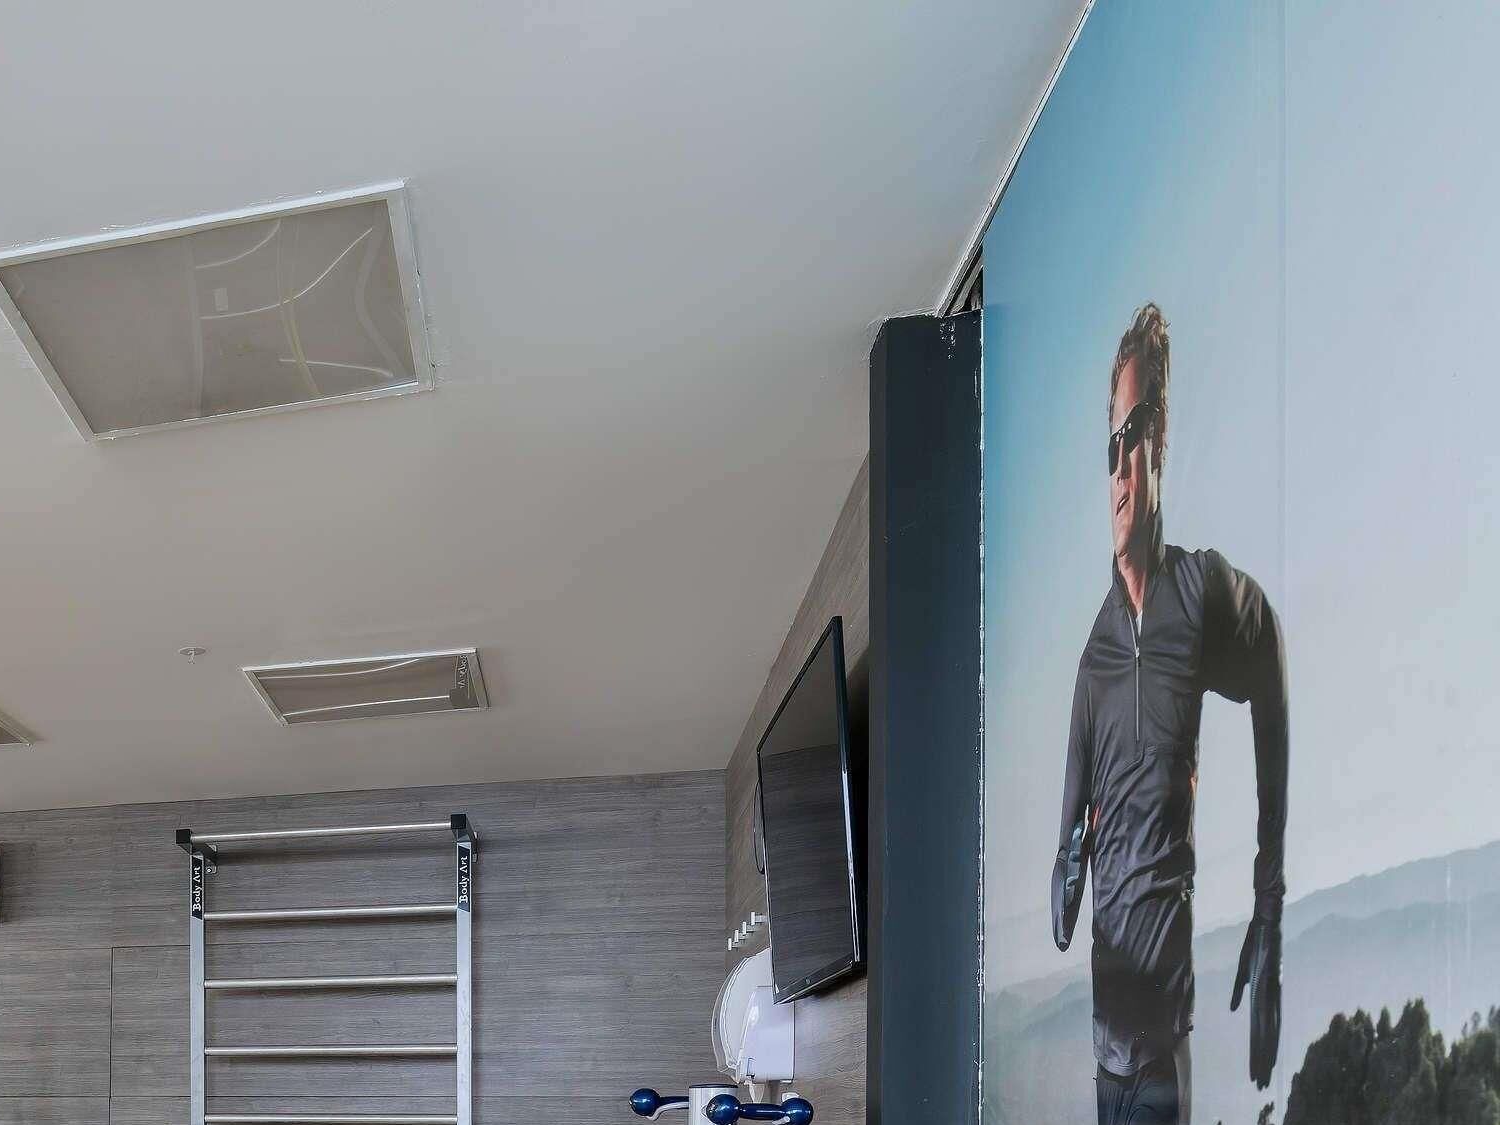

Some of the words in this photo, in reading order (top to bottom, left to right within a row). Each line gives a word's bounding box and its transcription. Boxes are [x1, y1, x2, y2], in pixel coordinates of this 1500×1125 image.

[192, 866, 201, 882] Art
[459, 856, 468, 873] Art
[192, 885, 203, 911] Body
[459, 875, 470, 903] Body
